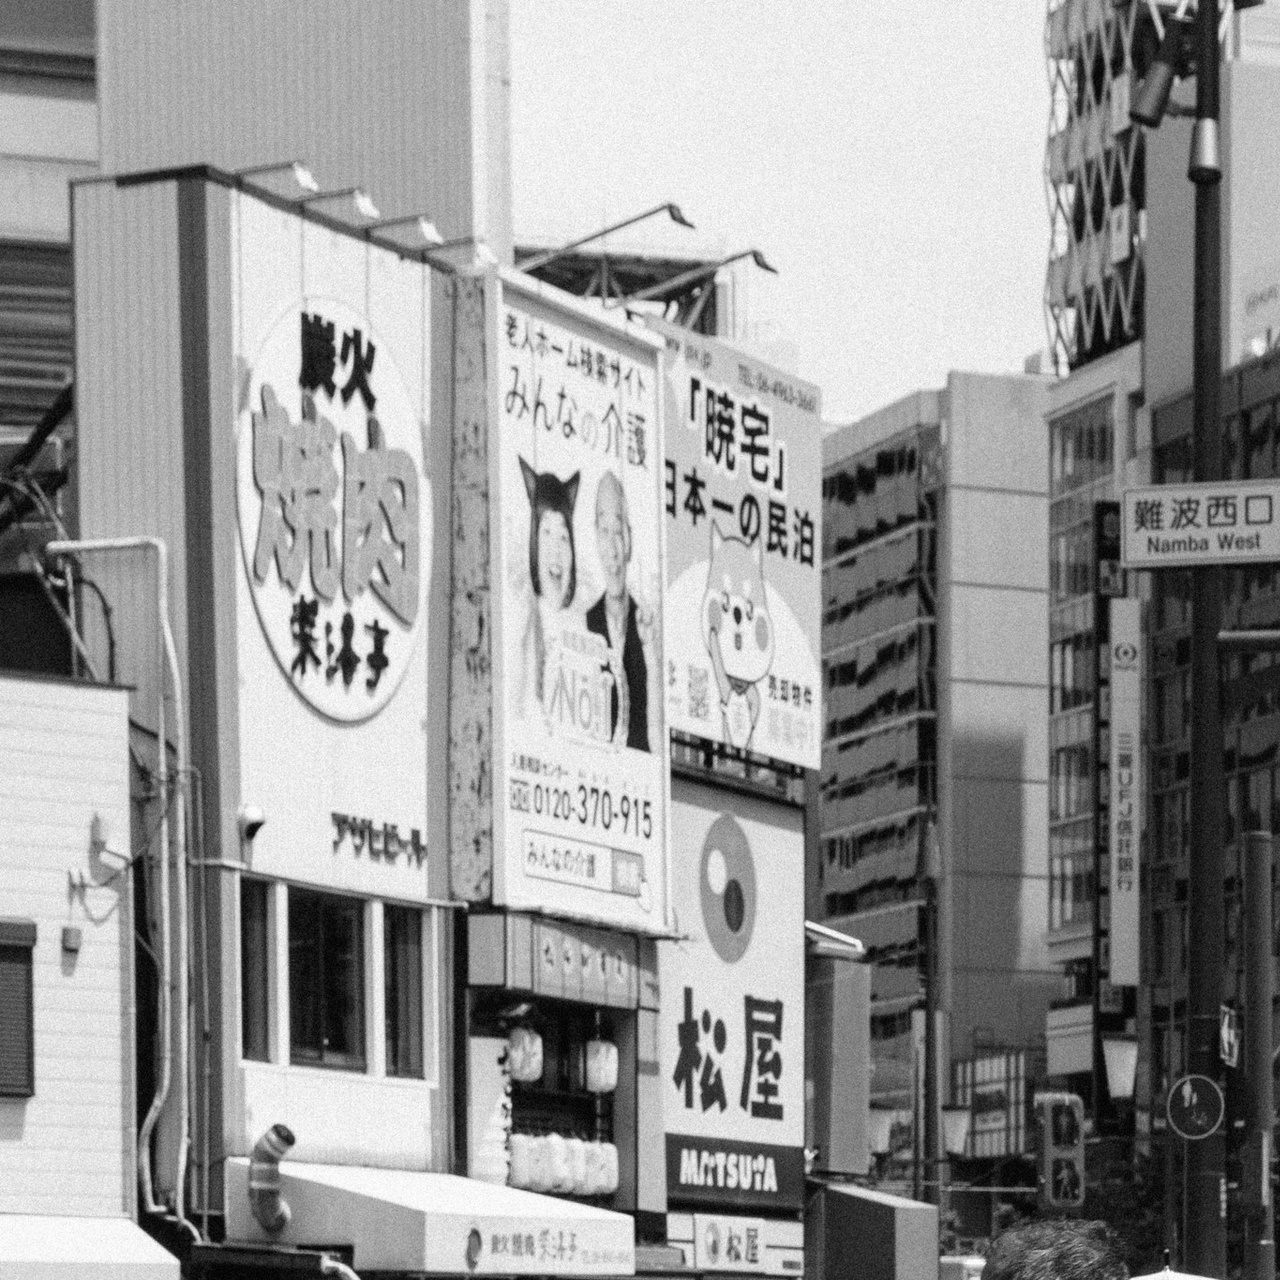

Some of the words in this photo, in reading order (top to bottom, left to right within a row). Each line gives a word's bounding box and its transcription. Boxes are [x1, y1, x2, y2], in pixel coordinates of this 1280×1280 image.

[299, 311, 377, 413] 炭火
[505, 365, 648, 471] みんなの介護
[664, 458, 814, 569] 日本一の民泊
[1134, 494, 1273, 533] 難波西口
[1146, 534, 1210, 554] Namba
[1216, 531, 1261, 551] West
[533, 783, 653, 839] 0120-370-915
[672, 985, 785, 1121] 松屋
[679, 1148, 779, 1192] MATSUYA
[725, 1226, 759, 1264] 松屋
